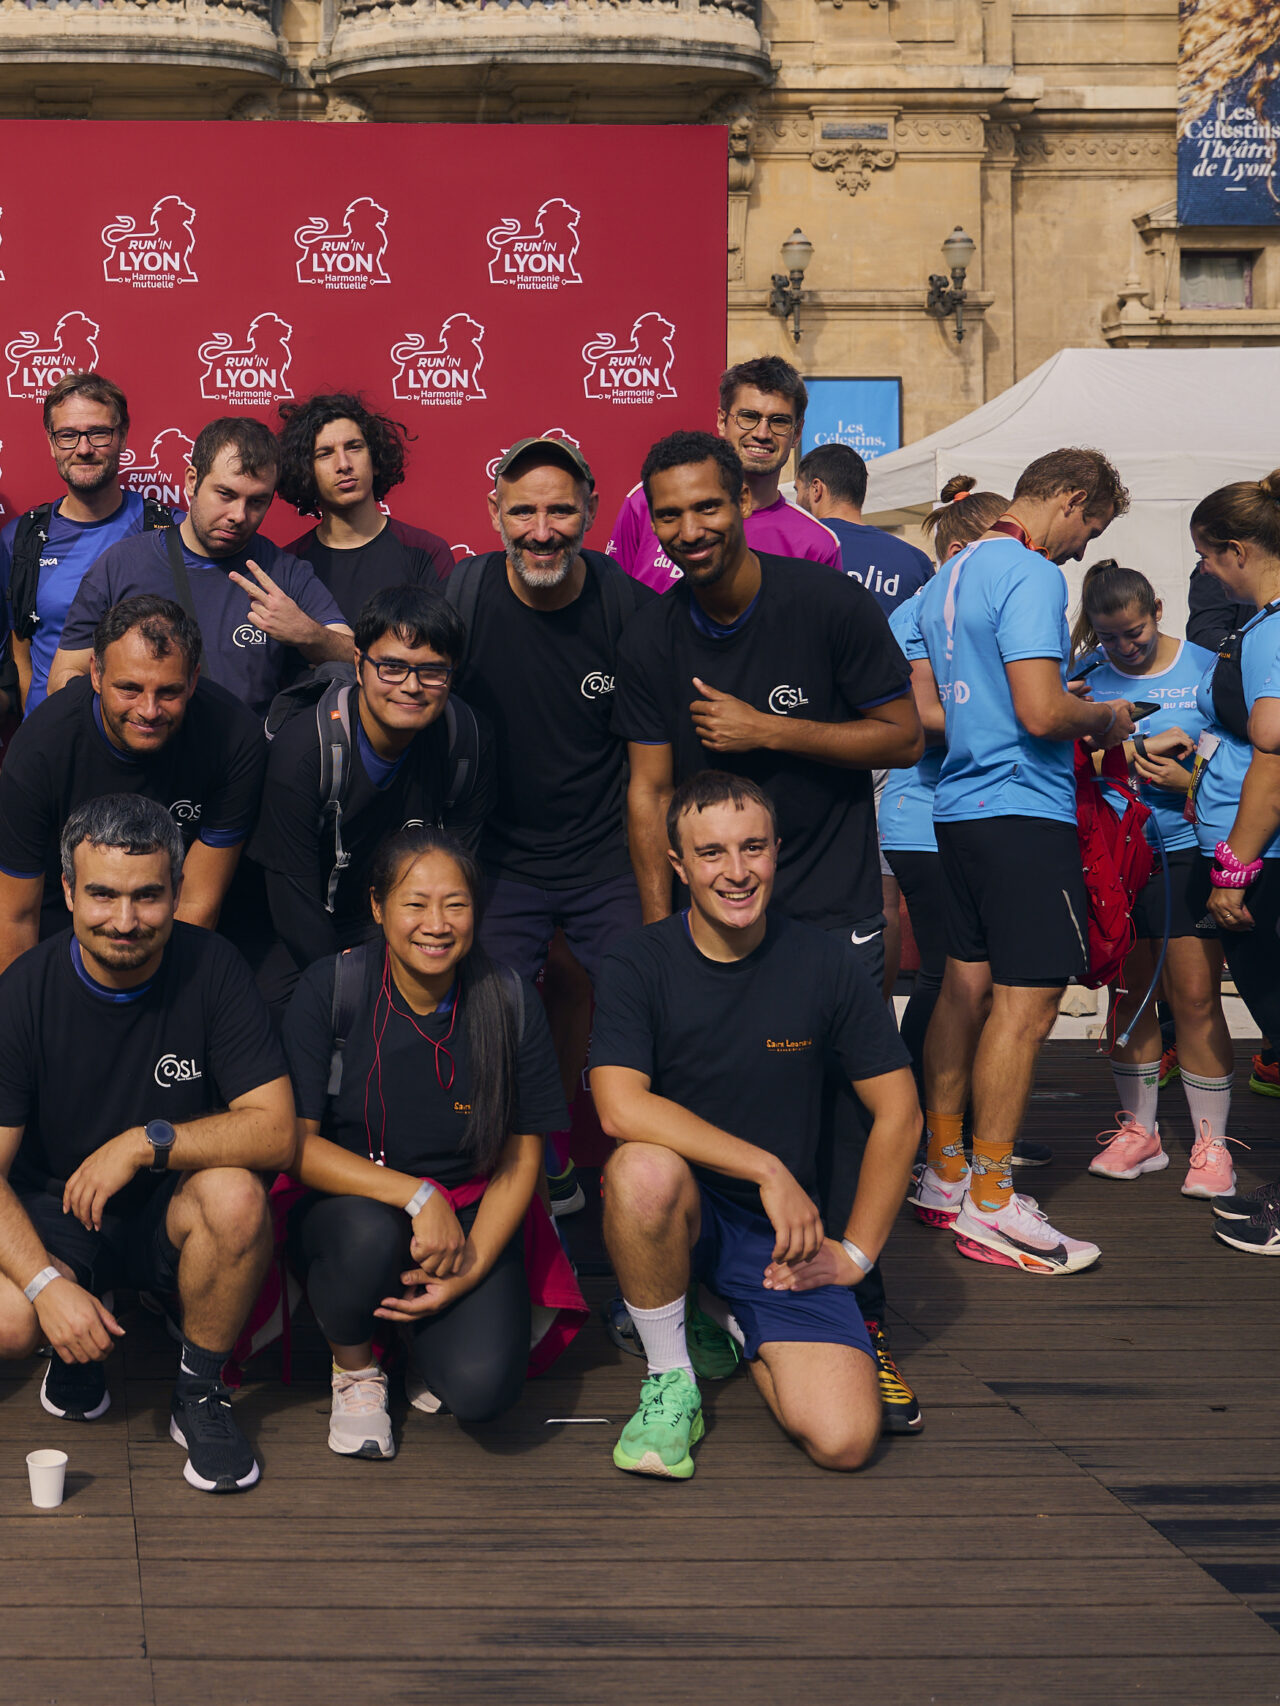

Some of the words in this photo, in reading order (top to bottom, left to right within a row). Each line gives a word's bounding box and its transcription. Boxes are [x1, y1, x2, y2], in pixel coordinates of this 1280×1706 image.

[1219, 102, 1257, 120] Les
[1197, 140, 1277, 159] Théâtre
[1192, 158, 1218, 177] de
[1221, 158, 1277, 181] Lyon.
[128, 237, 173, 250] RUN'IN
[321, 238, 365, 252] RUN'IN
[513, 239, 557, 252] RUN'IN
[119, 252, 180, 271] LYON
[312, 253, 373, 273] LYON
[504, 253, 565, 273] LYON
[132, 272, 176, 281] Harmonie
[325, 273, 368, 282] Harmonie
[517, 274, 560, 283] Harmonie
[132, 280, 174, 289] mutuelle
[325, 281, 367, 290] mutuelle
[517, 281, 558, 290] mutuelle
[31, 353, 76, 366] RUN'IN
[224, 355, 269, 367] RUN'IN
[417, 355, 461, 367] RUN'IN
[608, 354, 652, 367] RUN'IN
[216, 369, 277, 389] LYON
[408, 369, 469, 389] LYON
[599, 368, 659, 388] LYON
[228, 389, 272, 398] Harmonie
[420, 389, 464, 399] Harmonie
[612, 388, 655, 397] Harmonie
[229, 397, 271, 406] mutuelle
[421, 397, 463, 406] mutuelle
[612, 396, 654, 405] mutuelle
[837, 420, 863, 433] Les
[128, 470, 172, 483] RUN'IN
